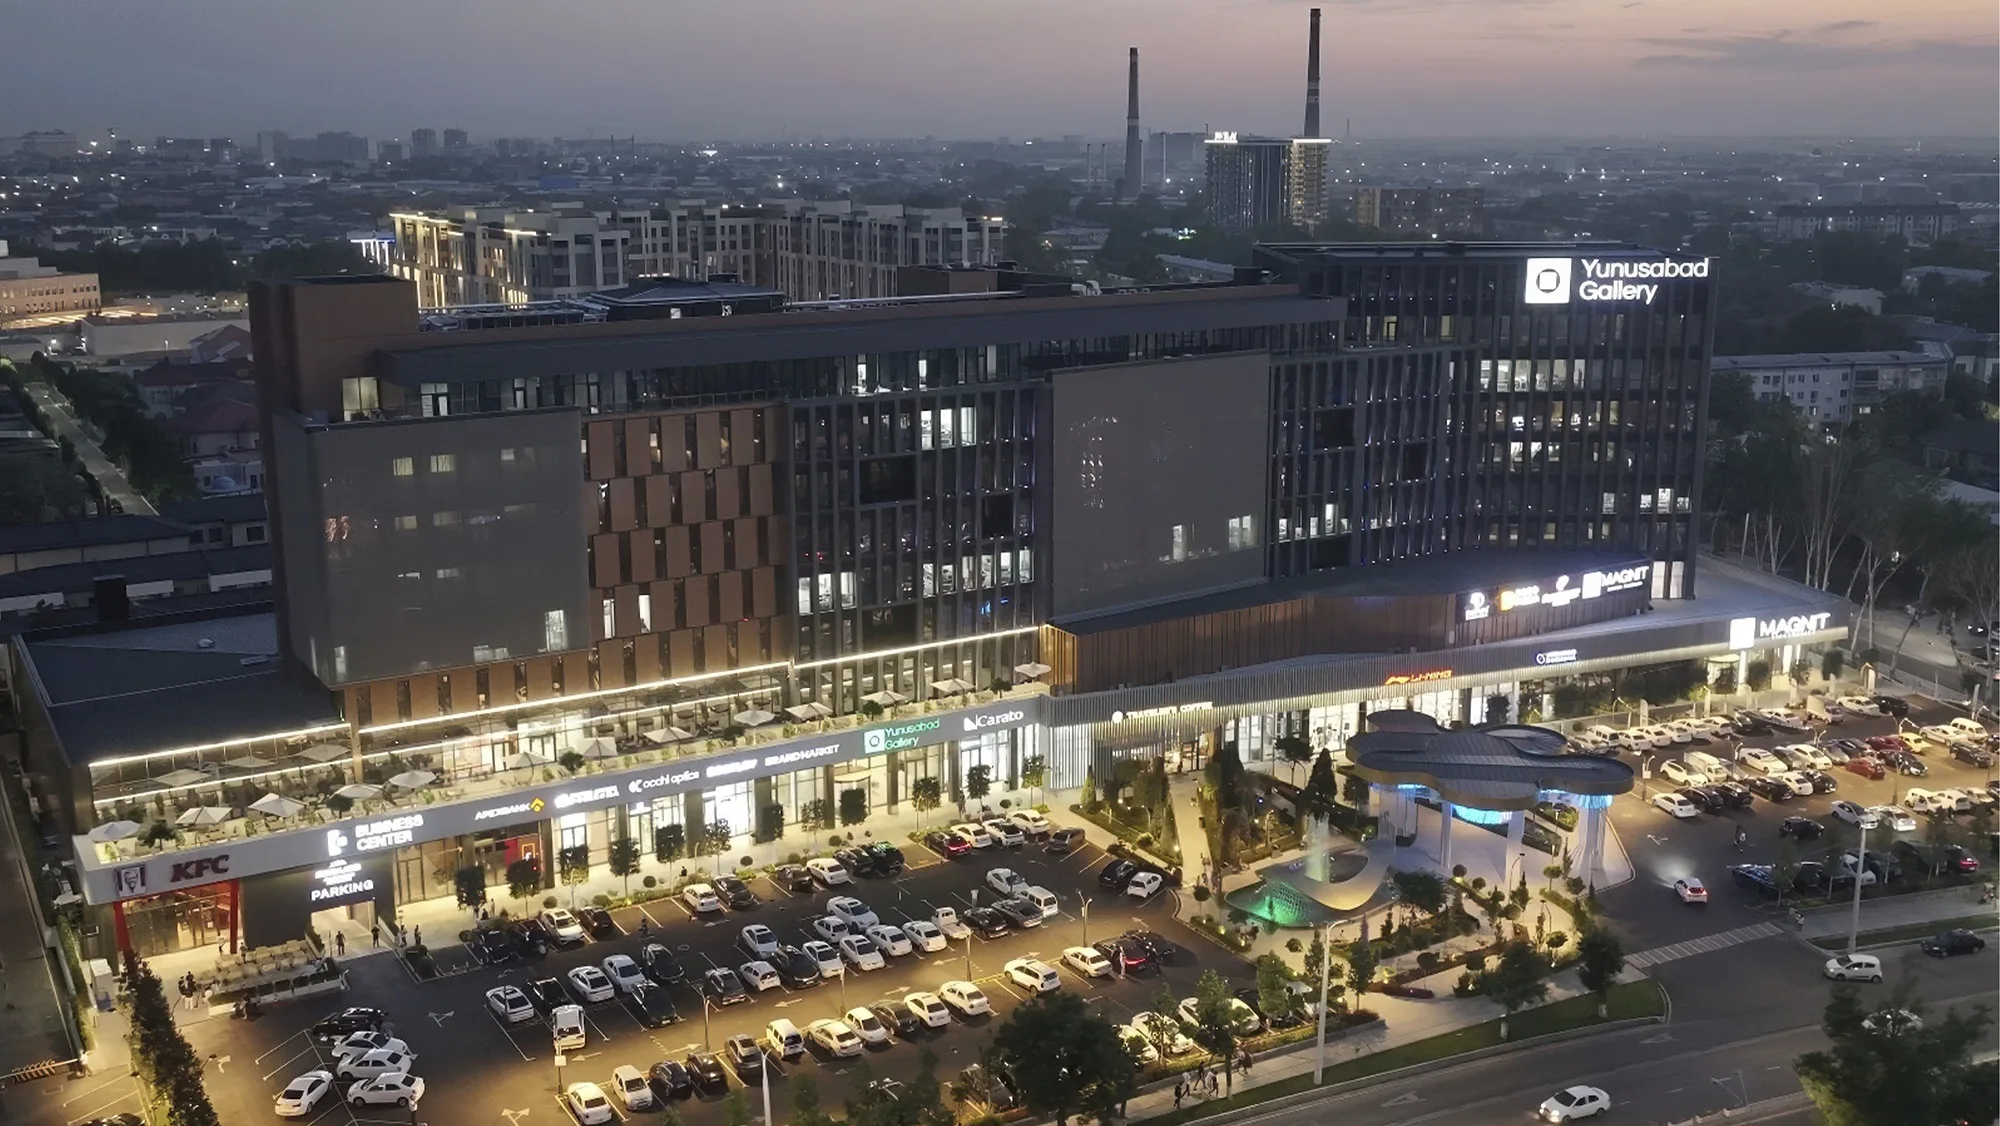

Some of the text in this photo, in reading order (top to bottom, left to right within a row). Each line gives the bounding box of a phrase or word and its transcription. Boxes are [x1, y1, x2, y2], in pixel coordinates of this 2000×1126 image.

[1580, 257, 1710, 278] Yunusabad
[1579, 280, 1659, 305] Gallery
[1601, 565, 1650, 587] MAGNIT
[1760, 612, 1832, 637] MAGNIT
[884, 718, 941, 738] Yunusabad
[977, 710, 1024, 727] Carato
[884, 736, 920, 750] Gallery
[356, 829, 413, 851] CENTER
[169, 854, 230, 883] KFC
[311, 879, 374, 901] PARKING
